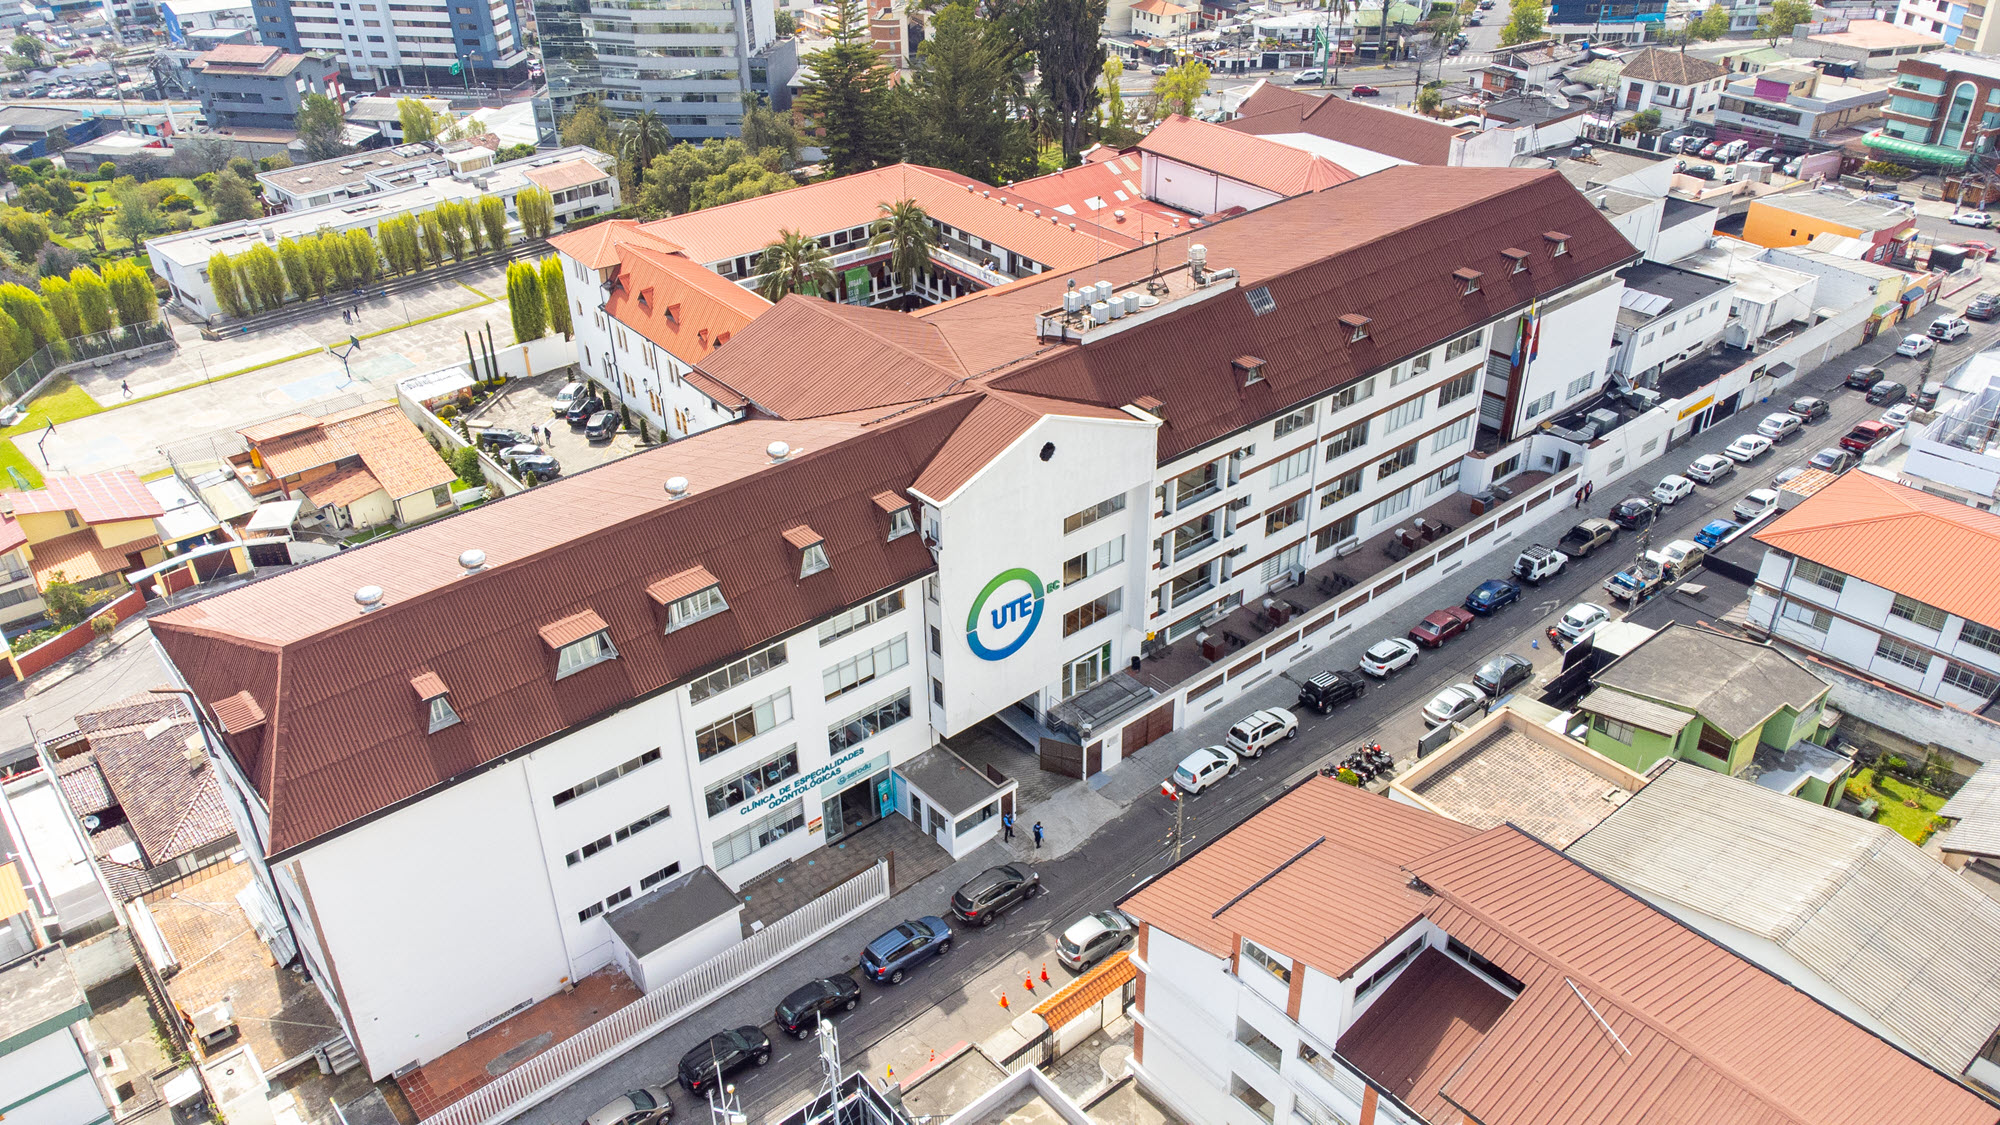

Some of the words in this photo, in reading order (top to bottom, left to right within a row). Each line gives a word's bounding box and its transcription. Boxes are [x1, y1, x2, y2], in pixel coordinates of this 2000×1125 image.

[991, 593, 1032, 629] UTE
[740, 794, 775, 815] CLÍNICA
[779, 784, 791, 795] DE
[795, 747, 864, 787] ESPECIALIDADES
[769, 767, 841, 809] ODONTOLÓGICAS
[847, 762, 872, 778] serodu
